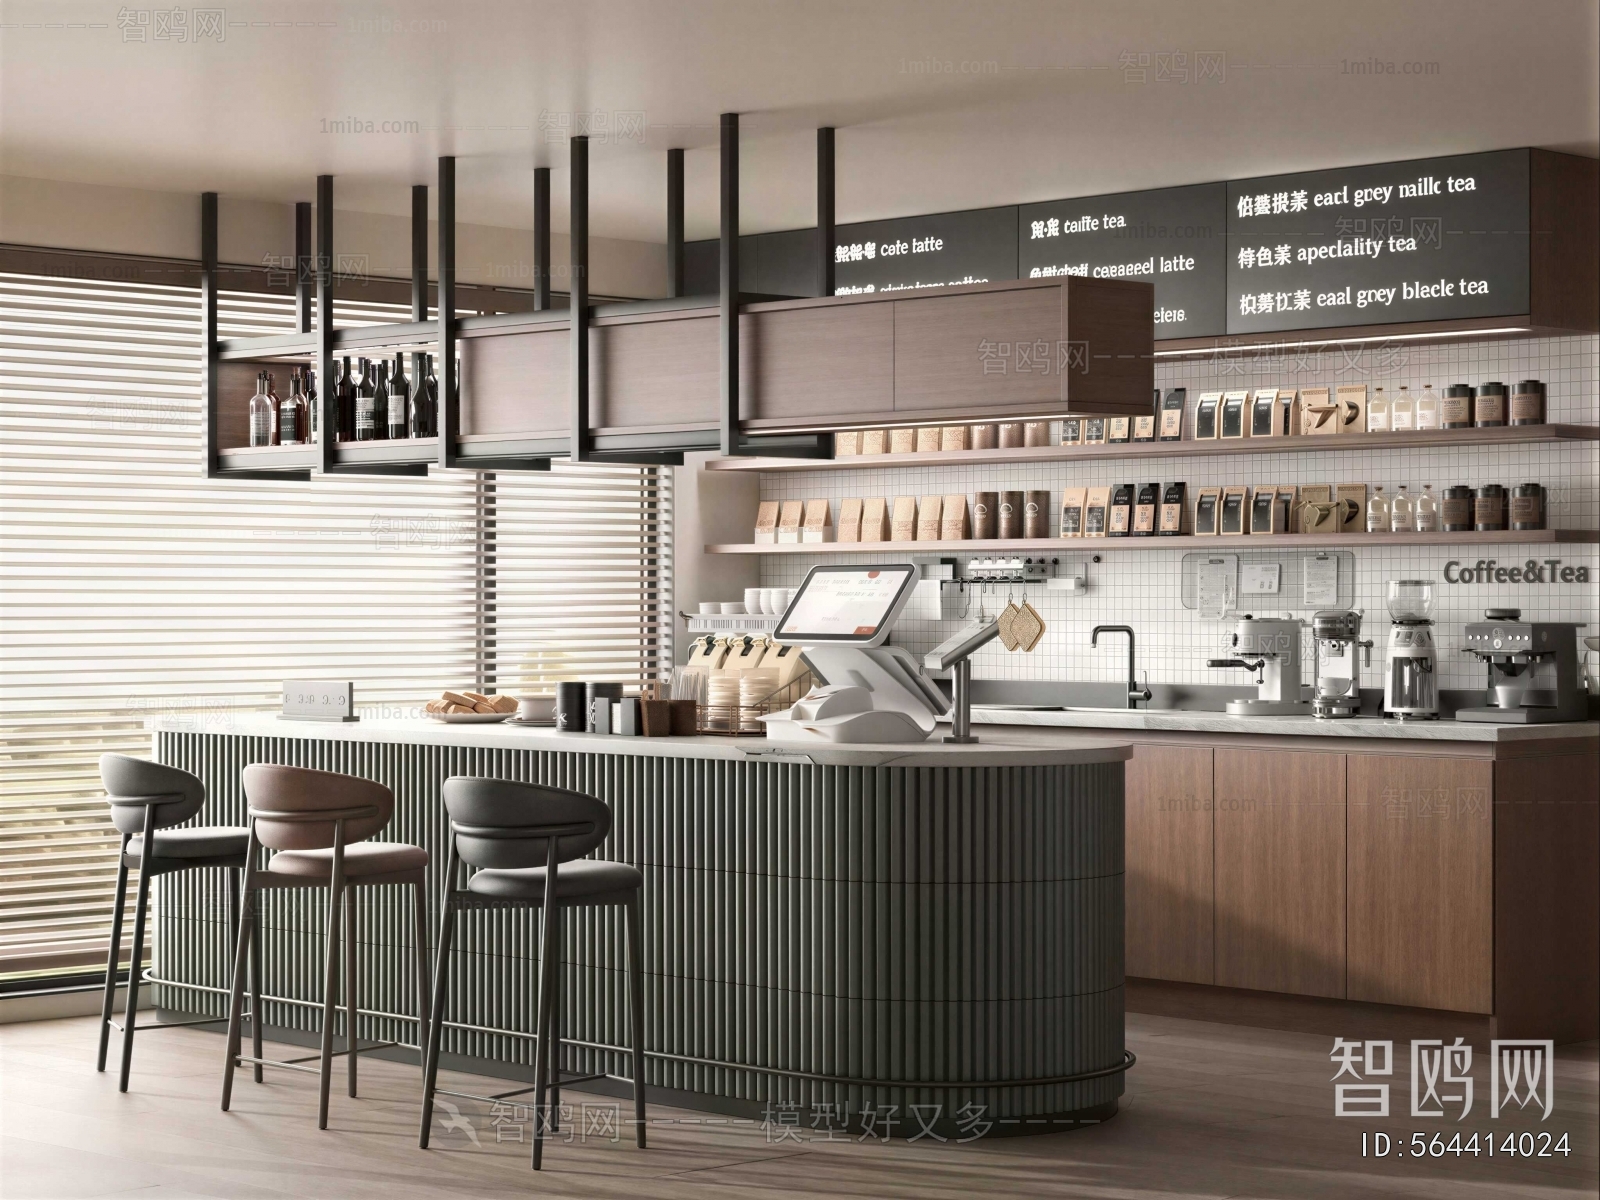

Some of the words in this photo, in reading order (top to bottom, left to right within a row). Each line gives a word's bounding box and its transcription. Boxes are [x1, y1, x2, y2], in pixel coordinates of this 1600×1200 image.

[1447, 176, 1477, 193] tea
[1388, 236, 1418, 252] tea
[1160, 255, 1195, 273] latte
[1459, 278, 1490, 296] tea
[1443, 559, 1590, 584] Coffee&Tea
